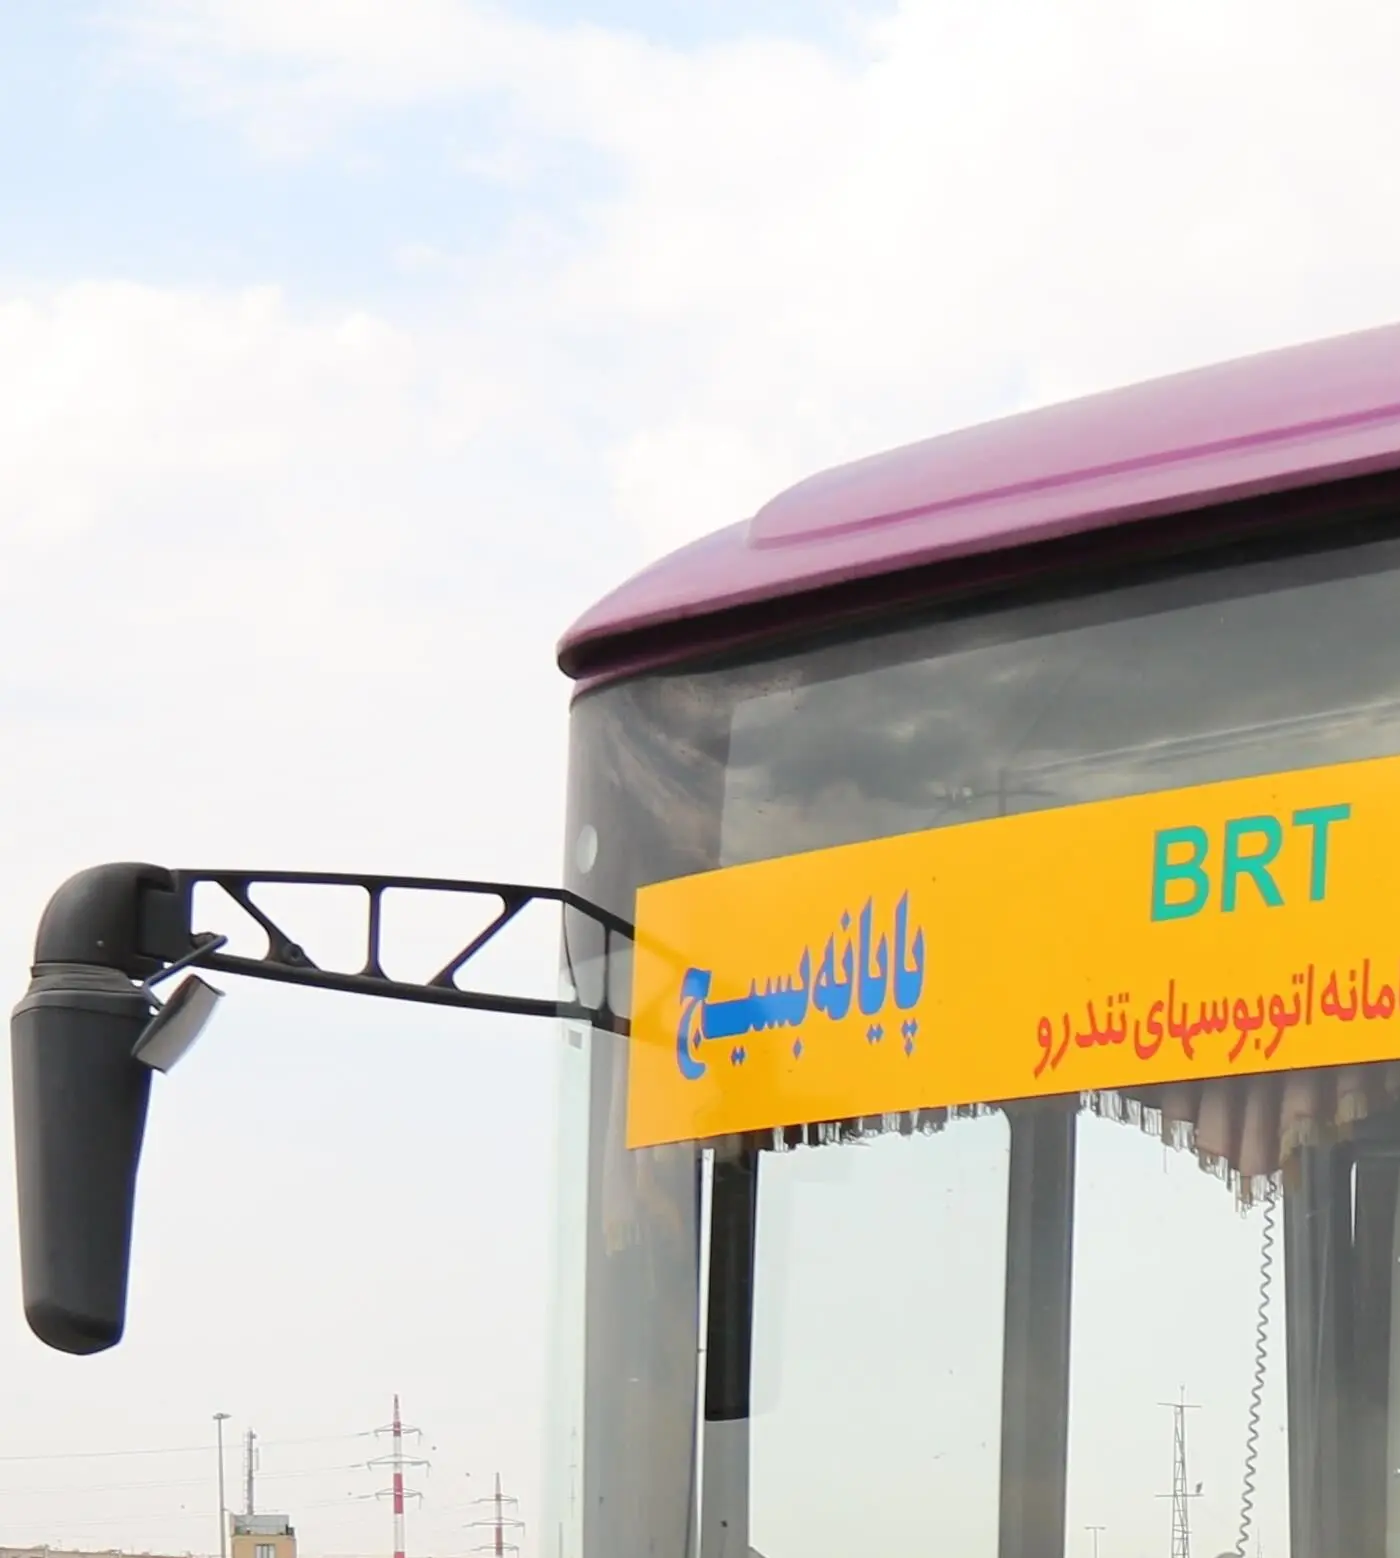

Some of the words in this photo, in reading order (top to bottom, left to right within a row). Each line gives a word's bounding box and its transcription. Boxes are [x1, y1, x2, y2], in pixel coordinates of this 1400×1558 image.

[1151, 803, 1354, 922] BRT
[675, 945, 811, 1081] بسیج
[813, 889, 926, 1056] پایانه
[1133, 962, 1315, 1063] اتوبوسهای
[1032, 992, 1131, 1078] تندرو
